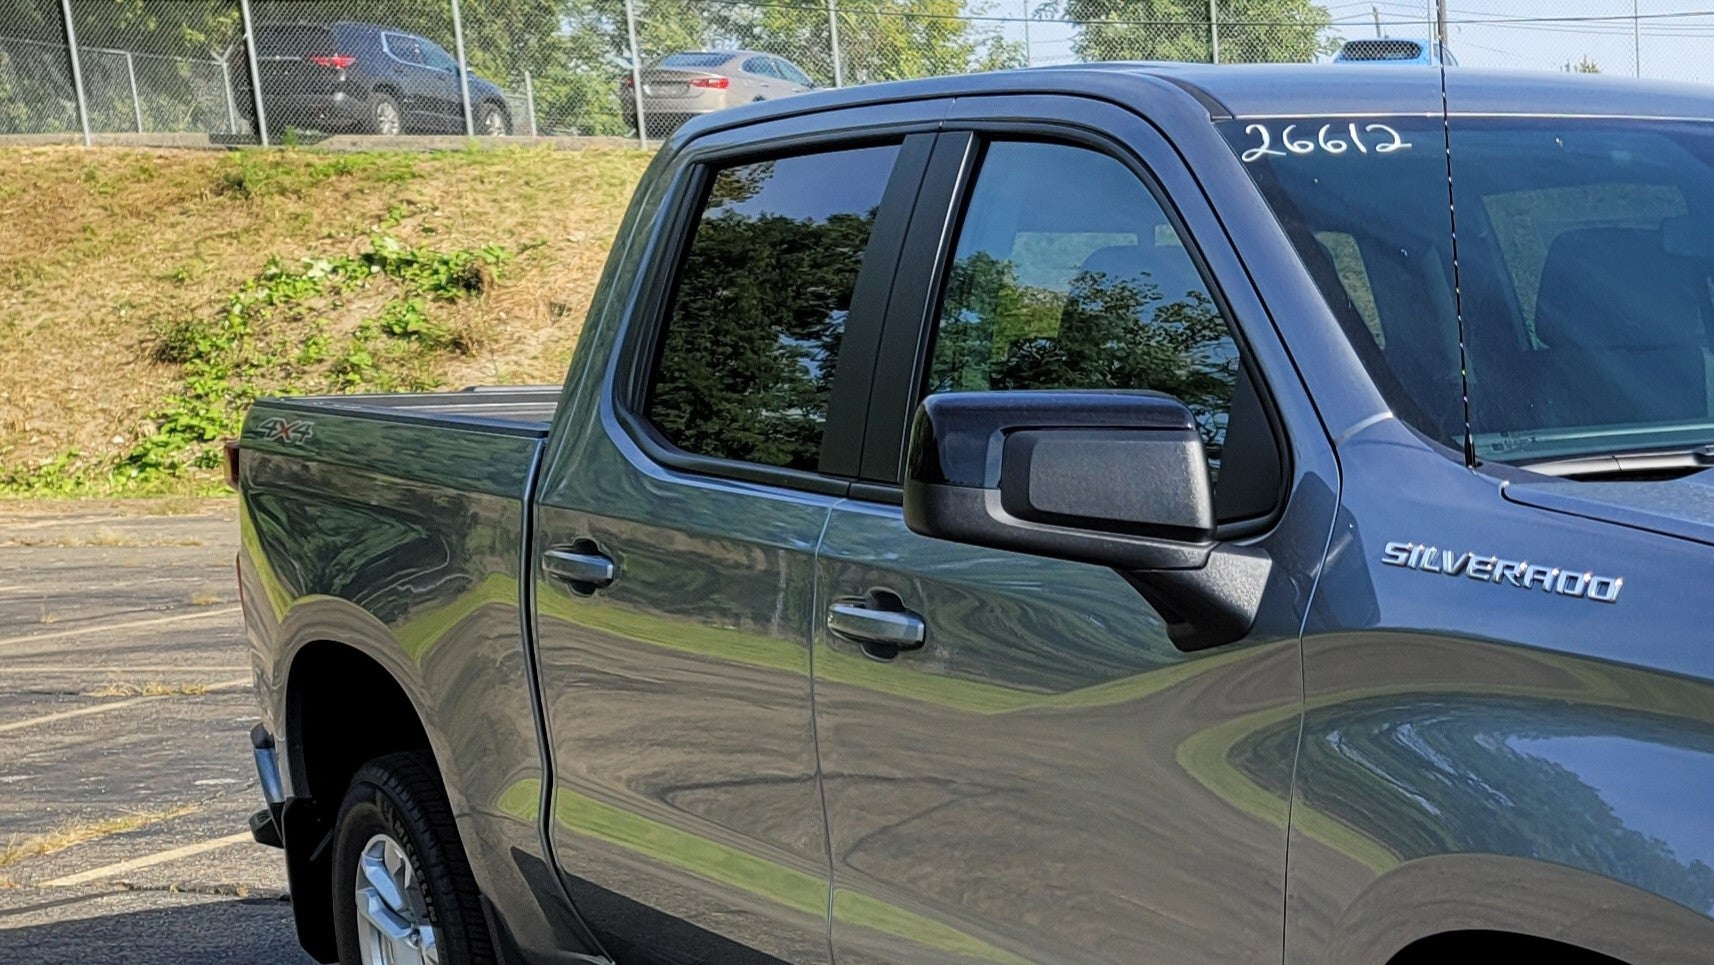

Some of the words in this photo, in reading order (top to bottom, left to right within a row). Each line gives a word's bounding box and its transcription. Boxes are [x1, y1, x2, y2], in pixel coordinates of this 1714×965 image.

[1241, 122, 1412, 163] 26612
[1381, 541, 1625, 603] SILVERADO
[394, 818, 438, 923] MICHELIN
